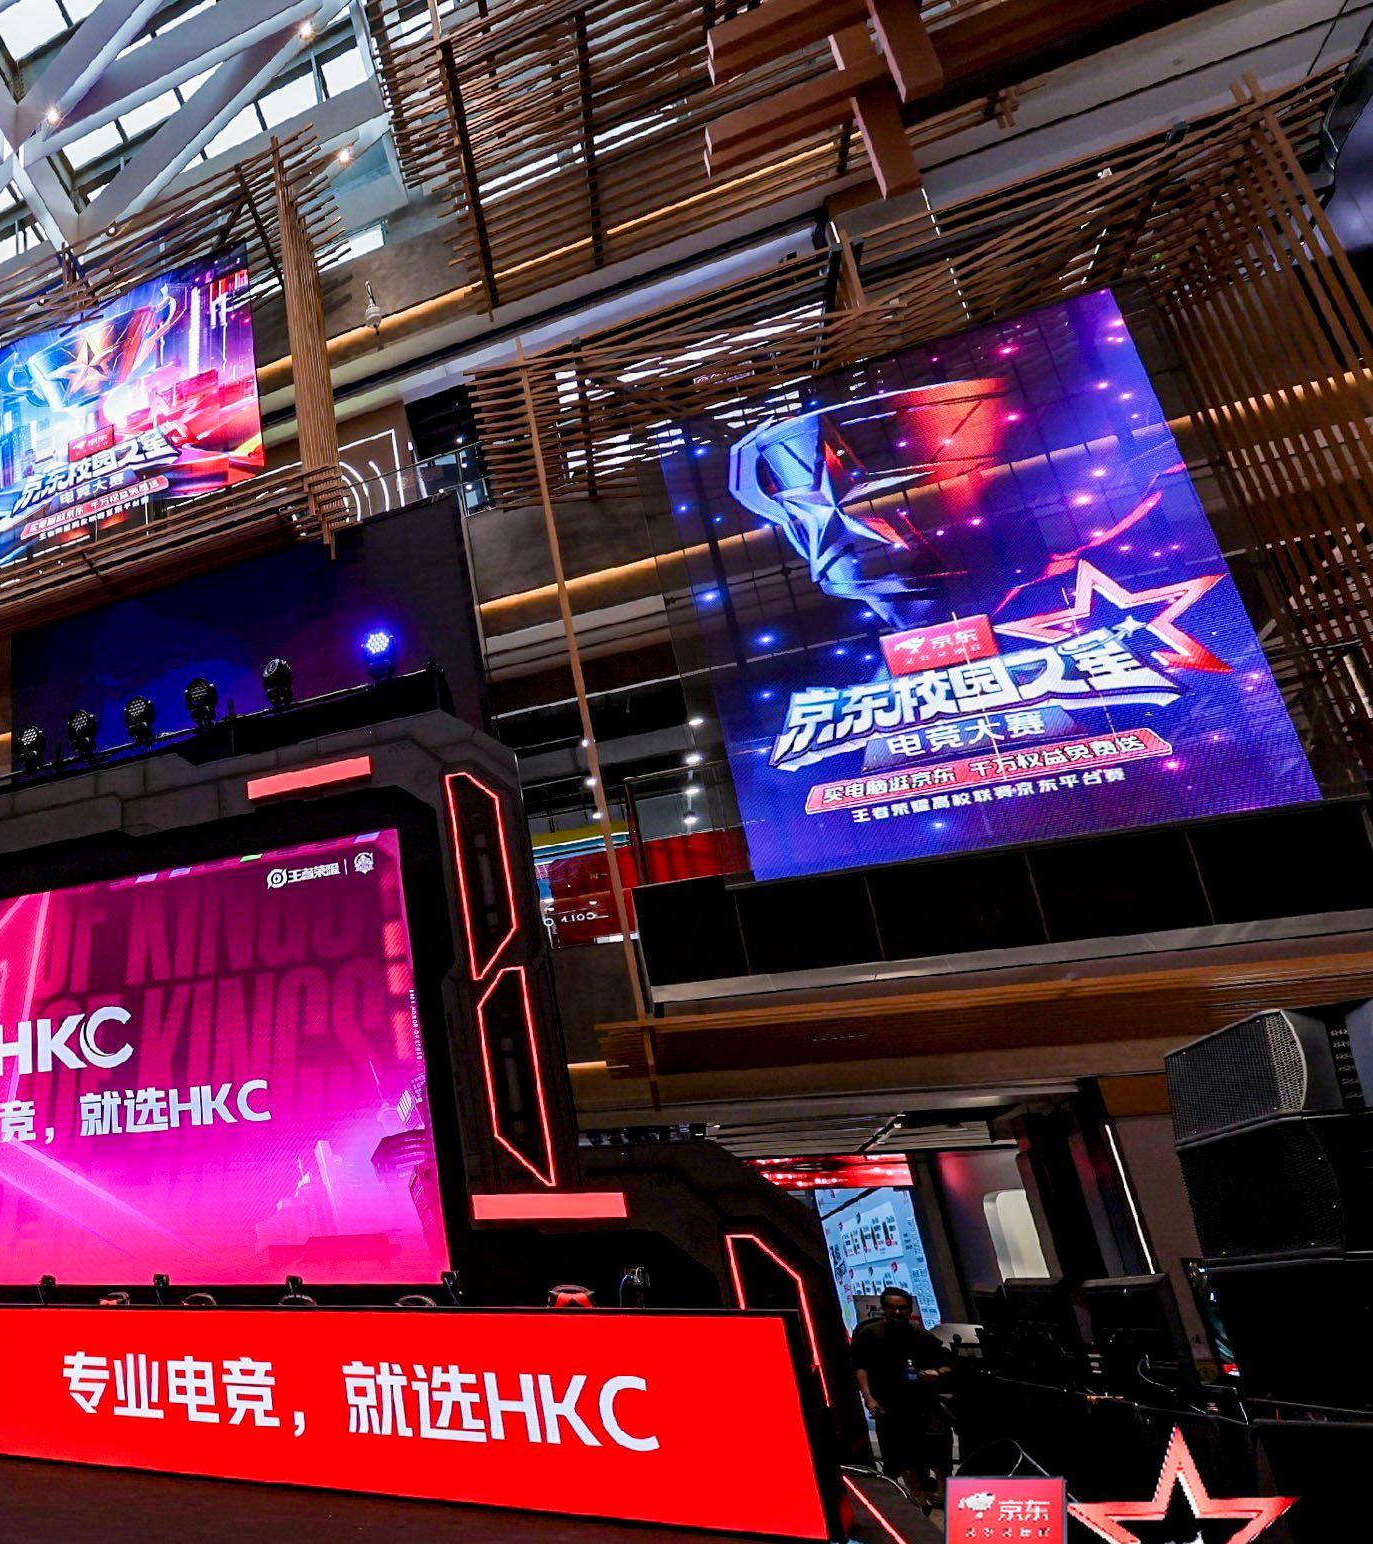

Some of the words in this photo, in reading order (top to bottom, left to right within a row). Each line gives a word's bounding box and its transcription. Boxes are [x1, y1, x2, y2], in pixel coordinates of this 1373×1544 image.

[13, 430, 180, 514] 京东校园之星
[59, 472, 126, 504] 电竞大赛
[930, 629, 979, 649] 京东
[774, 630, 1178, 763] 京东校园之星
[886, 711, 1046, 757] 电竞大赛
[821, 767, 956, 803] 买电脑逛京东
[969, 735, 1147, 778] 千万权益免费送
[851, 767, 1126, 823] 王者荣耀高校联赛京东平台赛
[288, 863, 340, 884] 王者荣耀
[62, 1351, 661, 1453] 专业电竞，就选HKC
[998, 1499, 1050, 1521] 京东
